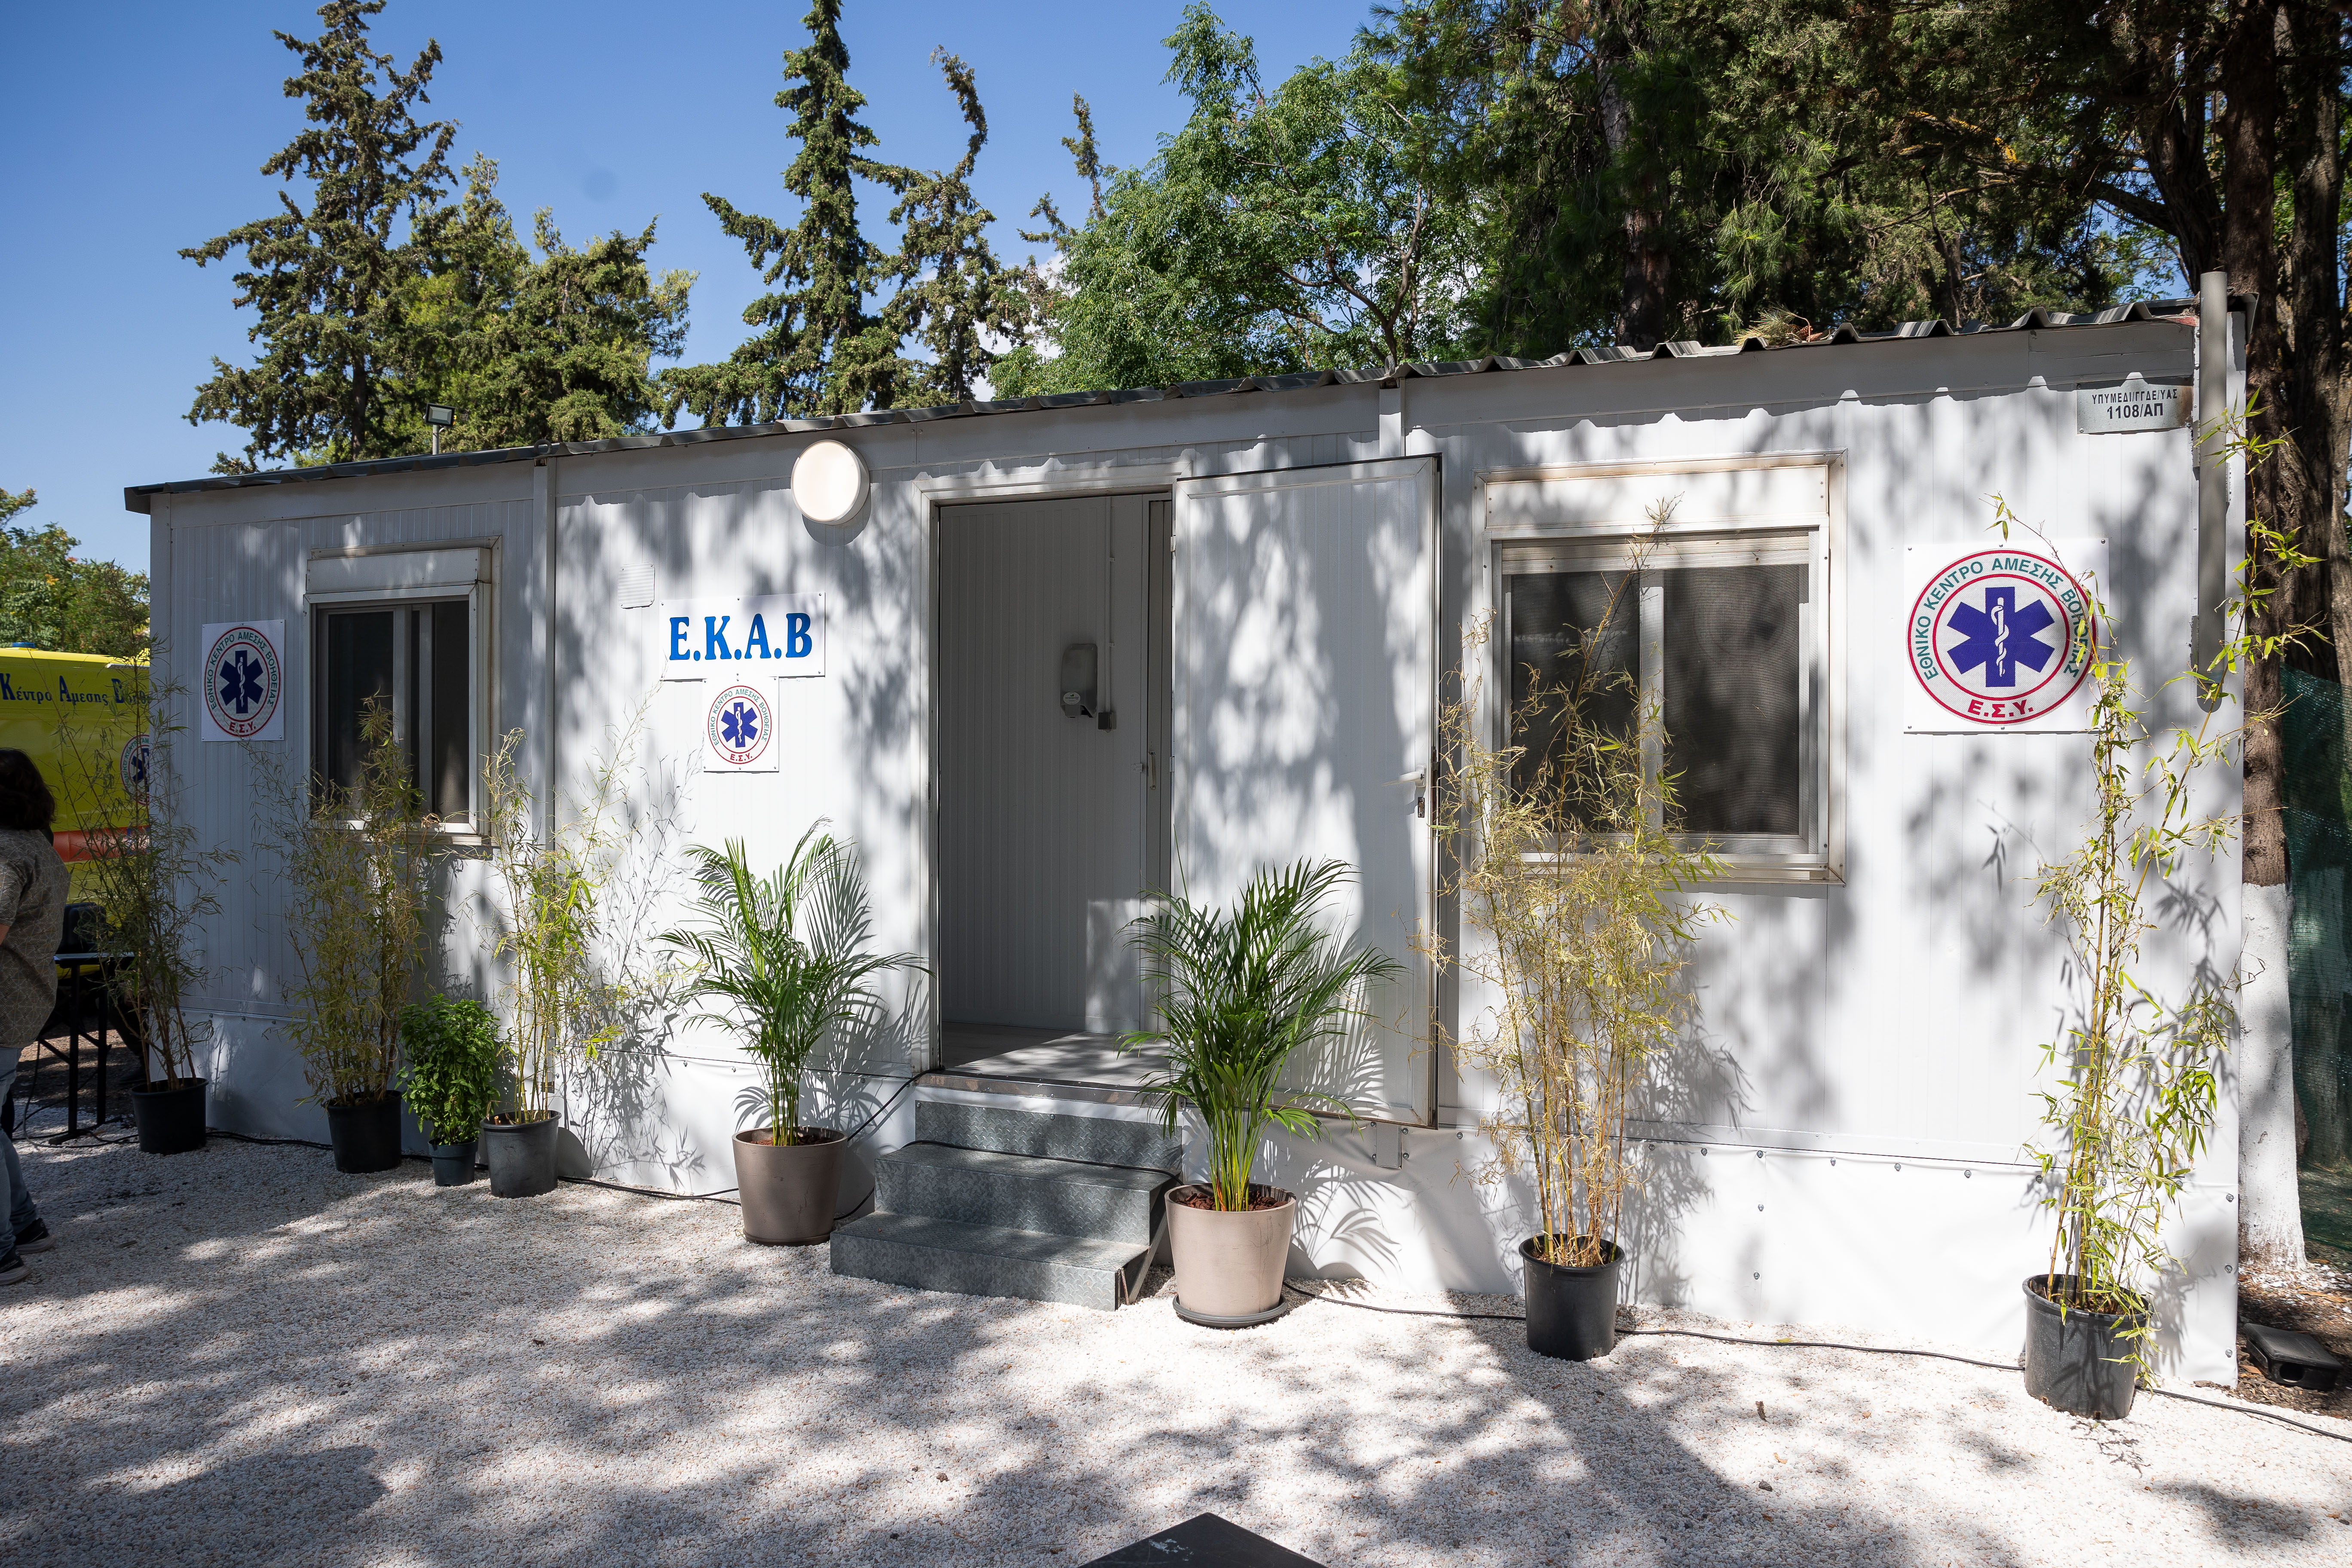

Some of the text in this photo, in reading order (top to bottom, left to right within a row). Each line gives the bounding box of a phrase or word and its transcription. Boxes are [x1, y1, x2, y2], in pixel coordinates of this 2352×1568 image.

[2092, 389, 2177, 404] ΥΠΥΜΕΔΙ/ΓΓΔΕ/ΥΑΣ
[2107, 403, 2163, 419] 1108/ΑΠ
[1924, 561, 1983, 610] ΚΕΝΤΡΟ
[1992, 557, 2064, 589] ΑΜΕΣΗΣ
[669, 612, 812, 661] Ε.Κ.Α.Β
[1915, 616, 1939, 680] ΕΘΝΙΚΟ
[207, 632, 277, 710] ΕΘΝΙΚΟ ΚΕΝΤΡΟ ΑΜΕΣΗΣ ΒΟΗΘΕΙΑΣ
[0, 673, 52, 704] Κέντρο
[710, 689, 769, 746] ΕΘΝΙΚΟ ΚΕΝΤΡΟ ΑΜΕΣΗΣ ΒΟΗΘΕΙΑΣ
[1968, 699, 2034, 718] Ε.Σ.Υ.
[229, 721, 256, 733] Ε.Σ.Υ.
[730, 753, 753, 761] Ε.Σ.Υ.
